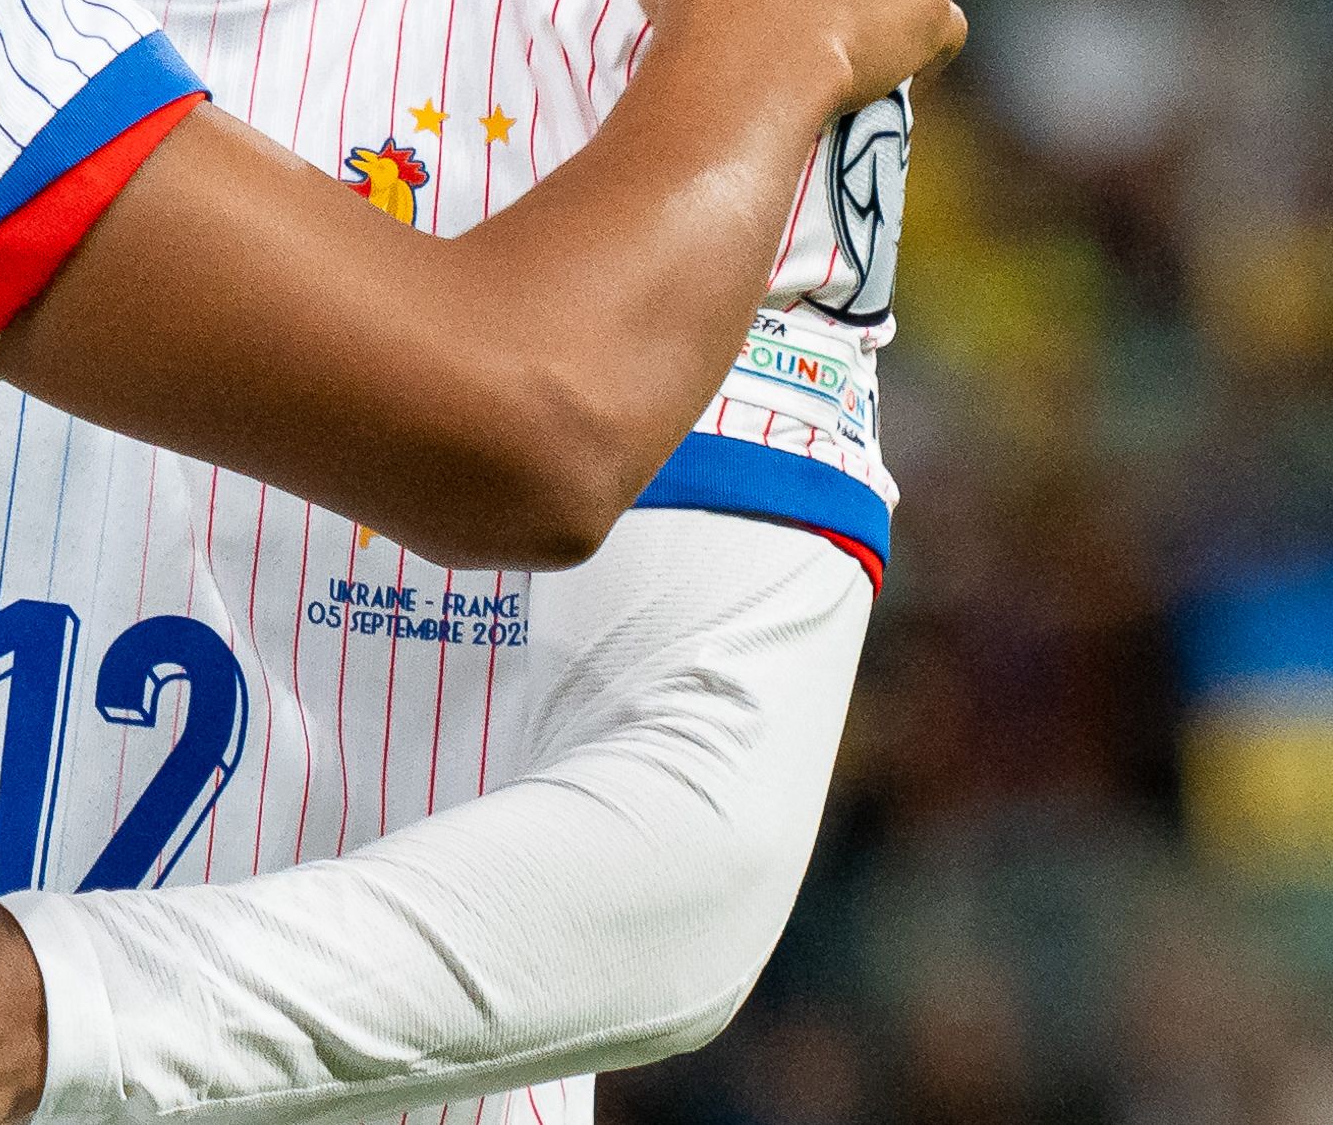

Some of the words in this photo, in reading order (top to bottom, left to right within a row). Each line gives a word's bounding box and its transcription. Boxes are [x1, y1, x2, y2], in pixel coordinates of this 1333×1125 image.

[750, 314, 787, 337] EFA
[741, 342, 865, 419] OUNDON
[329, 578, 417, 611] UKRAINE
[441, 592, 520, 618] FRANCE
[307, 601, 341, 628] 05
[350, 611, 463, 644] SEPTEMBRE
